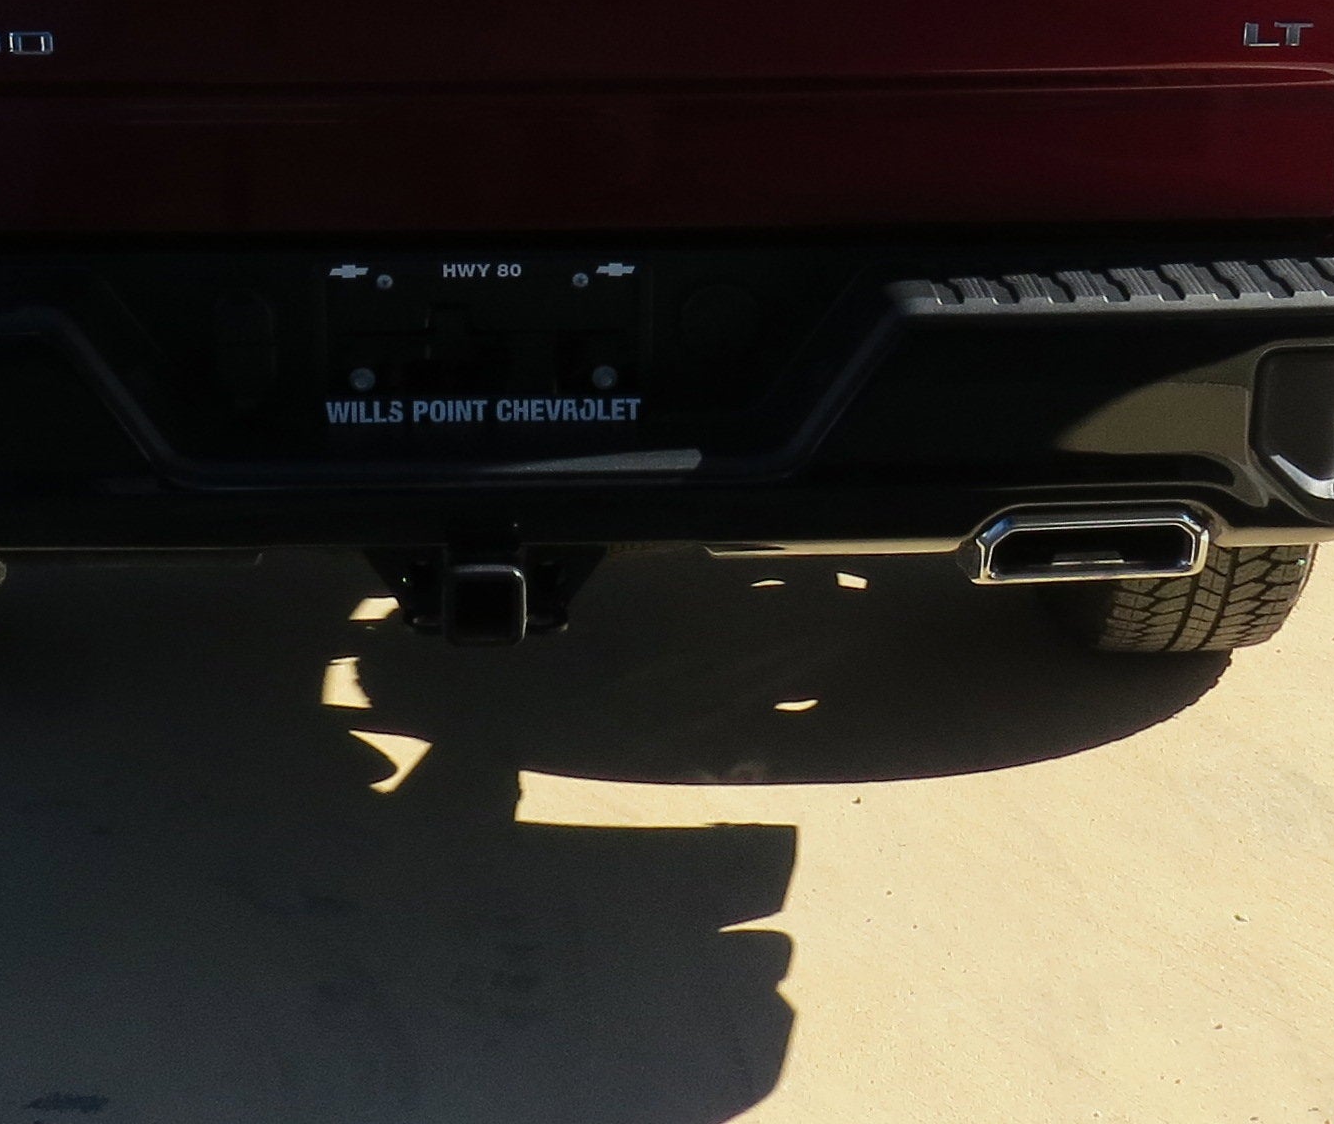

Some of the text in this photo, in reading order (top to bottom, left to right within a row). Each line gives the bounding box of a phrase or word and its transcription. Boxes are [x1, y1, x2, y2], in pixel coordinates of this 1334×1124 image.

[1243, 21, 1315, 47] LT
[442, 263, 522, 277] HWY 80
[325, 398, 642, 424] WILLS POINT CHEVROLET
